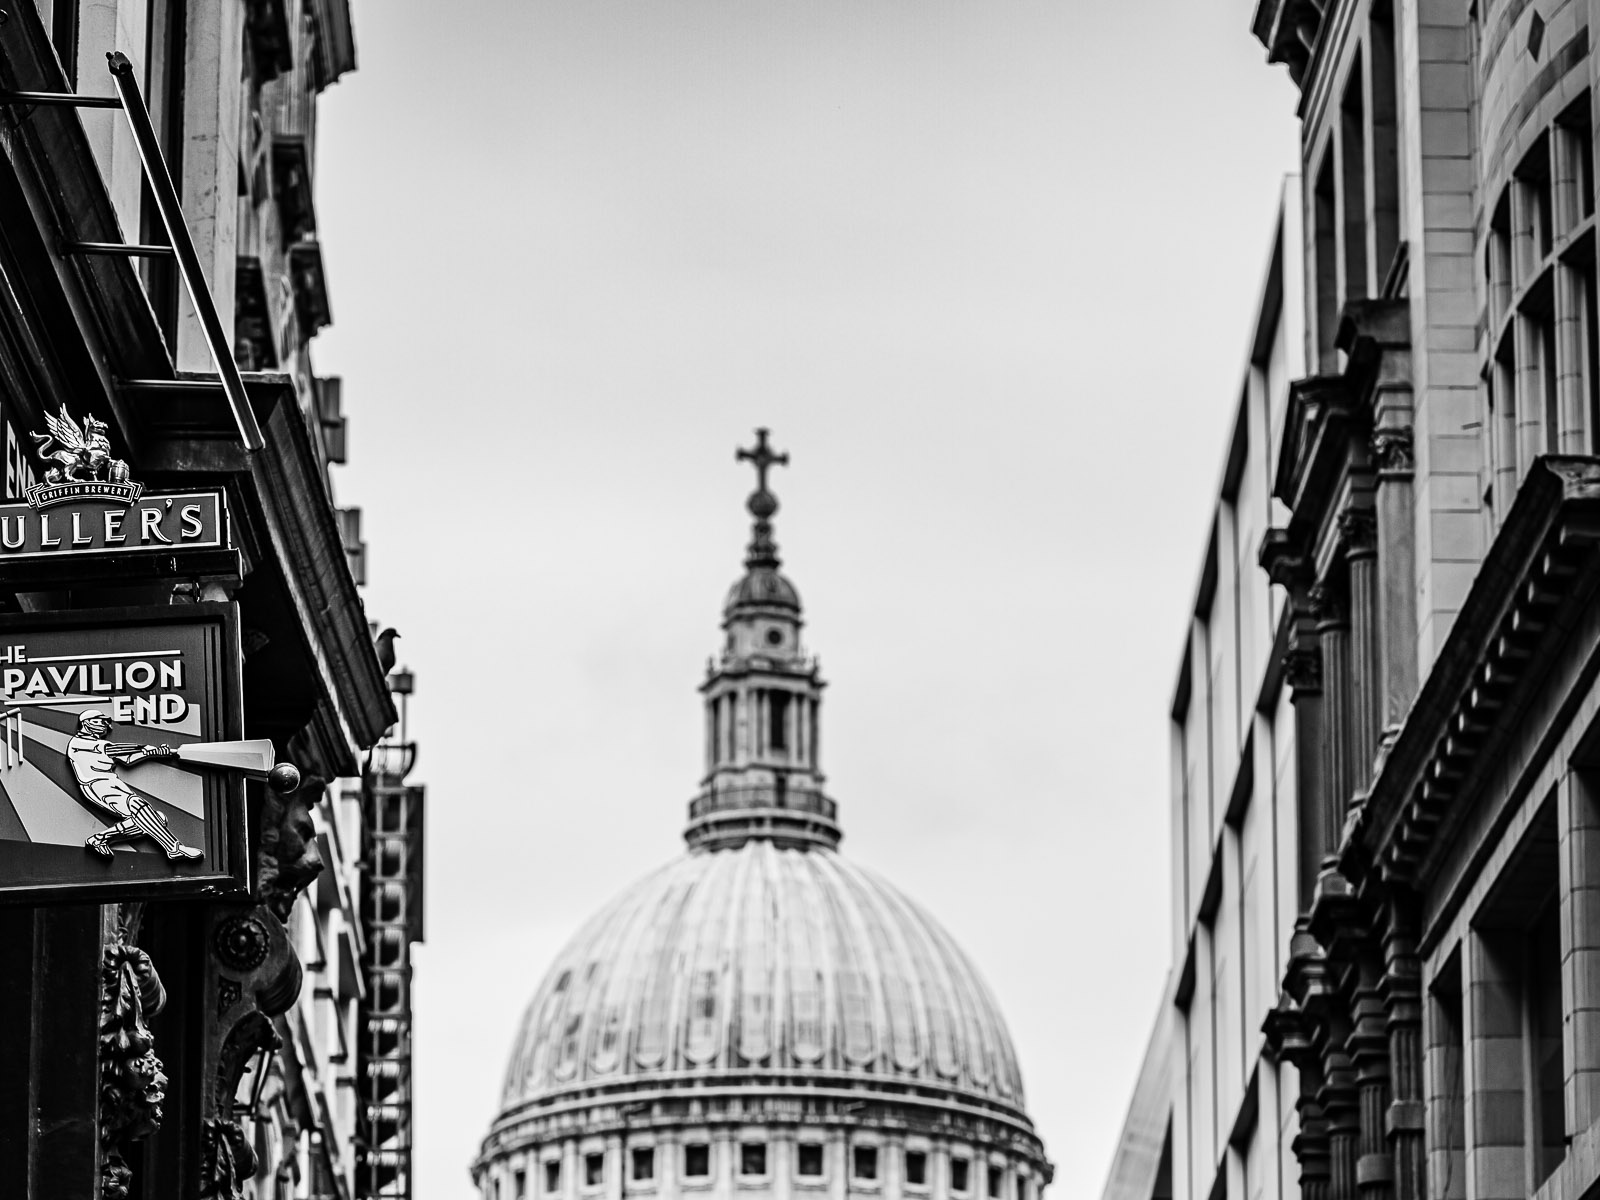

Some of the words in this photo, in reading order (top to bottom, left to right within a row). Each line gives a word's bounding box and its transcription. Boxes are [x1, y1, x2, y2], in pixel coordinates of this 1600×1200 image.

[41, 486, 80, 500] GRIFFIN
[85, 486, 128, 496] BREWERY
[1, 499, 203, 549] ULLER'S
[0, 645, 26, 664] HE
[3, 660, 182, 695] PAVILION
[113, 694, 187, 722] END
